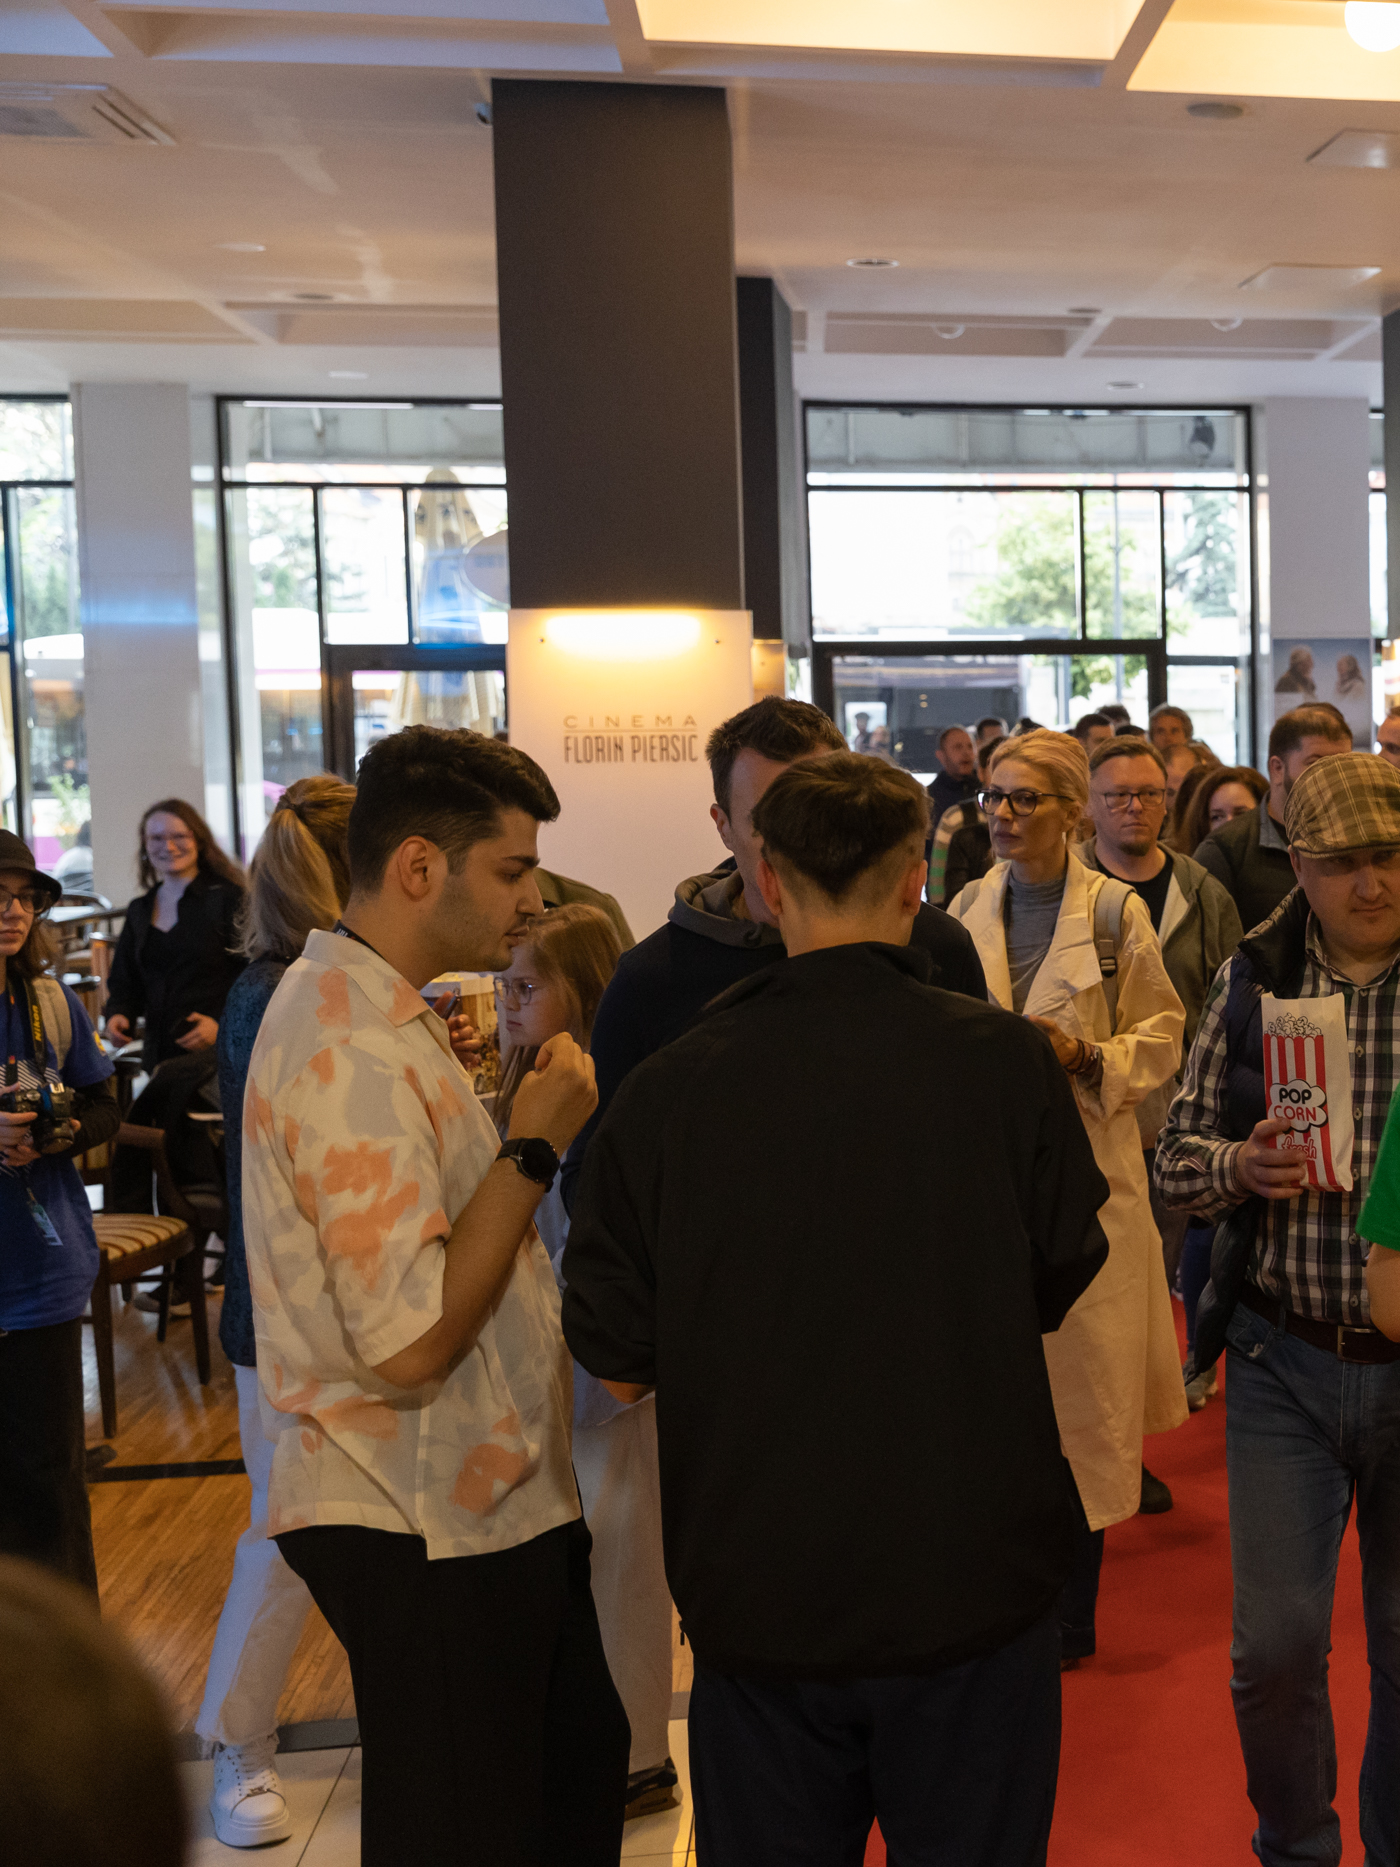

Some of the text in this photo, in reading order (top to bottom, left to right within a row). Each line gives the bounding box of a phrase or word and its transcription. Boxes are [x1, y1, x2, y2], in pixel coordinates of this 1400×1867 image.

[563, 715, 697, 728] CINEMA
[564, 734, 698, 763] FLORIN PIERSIC
[32, 1004, 42, 1041] Nikon
[1279, 1087, 1312, 1104] POP
[1274, 1105, 1317, 1121] CORN
